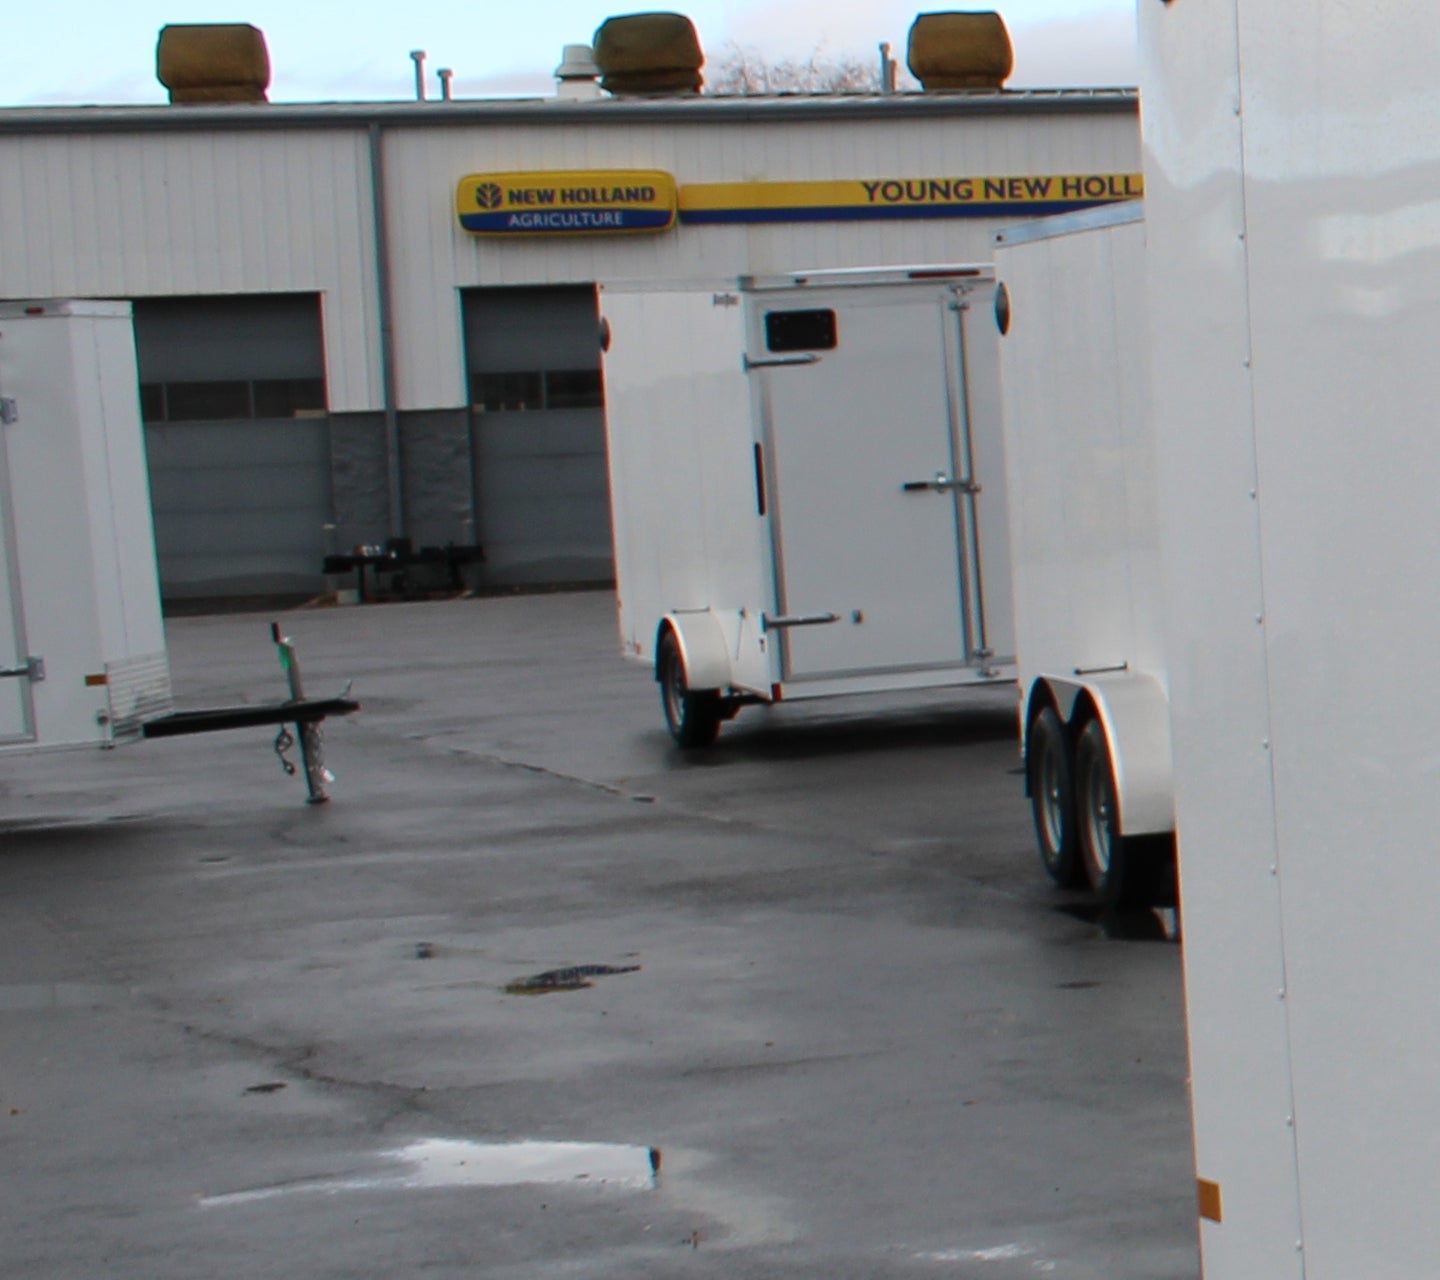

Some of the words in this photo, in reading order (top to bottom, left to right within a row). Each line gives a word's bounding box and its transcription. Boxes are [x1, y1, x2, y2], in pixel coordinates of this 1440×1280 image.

[508, 188, 556, 205] NEW
[561, 187, 655, 202] HOLLAND
[861, 179, 973, 203] YOUNG
[983, 178, 1052, 199] NEW
[1061, 175, 1144, 198] HOLL
[508, 211, 624, 228] AGRICULTURE
